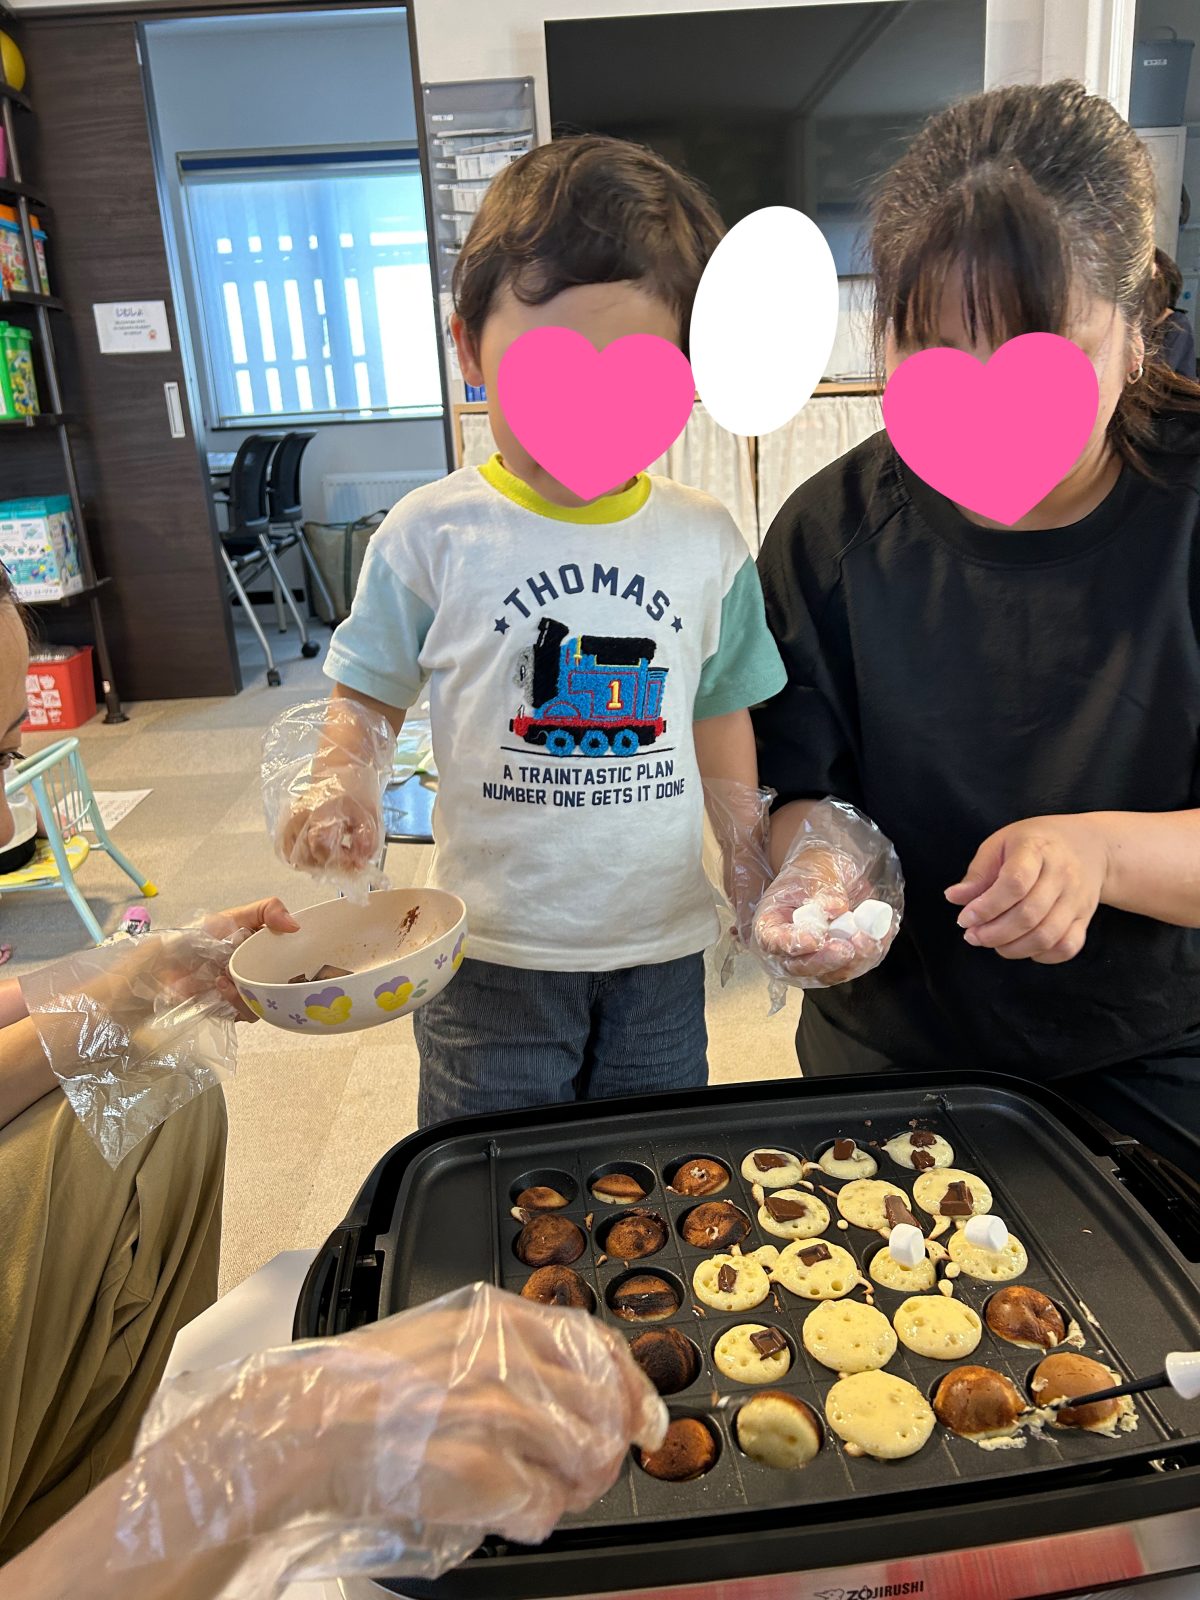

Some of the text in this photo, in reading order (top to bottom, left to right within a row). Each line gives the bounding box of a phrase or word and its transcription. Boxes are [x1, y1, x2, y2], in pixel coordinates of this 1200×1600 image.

[503, 563, 670, 621] THOMAS
[606, 680, 624, 710] 1
[503, 760, 674, 785] A TRAINTASTIC PLAN
[483, 777, 685, 807] NUMBER ONE GETS IT DONE
[847, 1581, 924, 1600] ZOJIRUSHI
